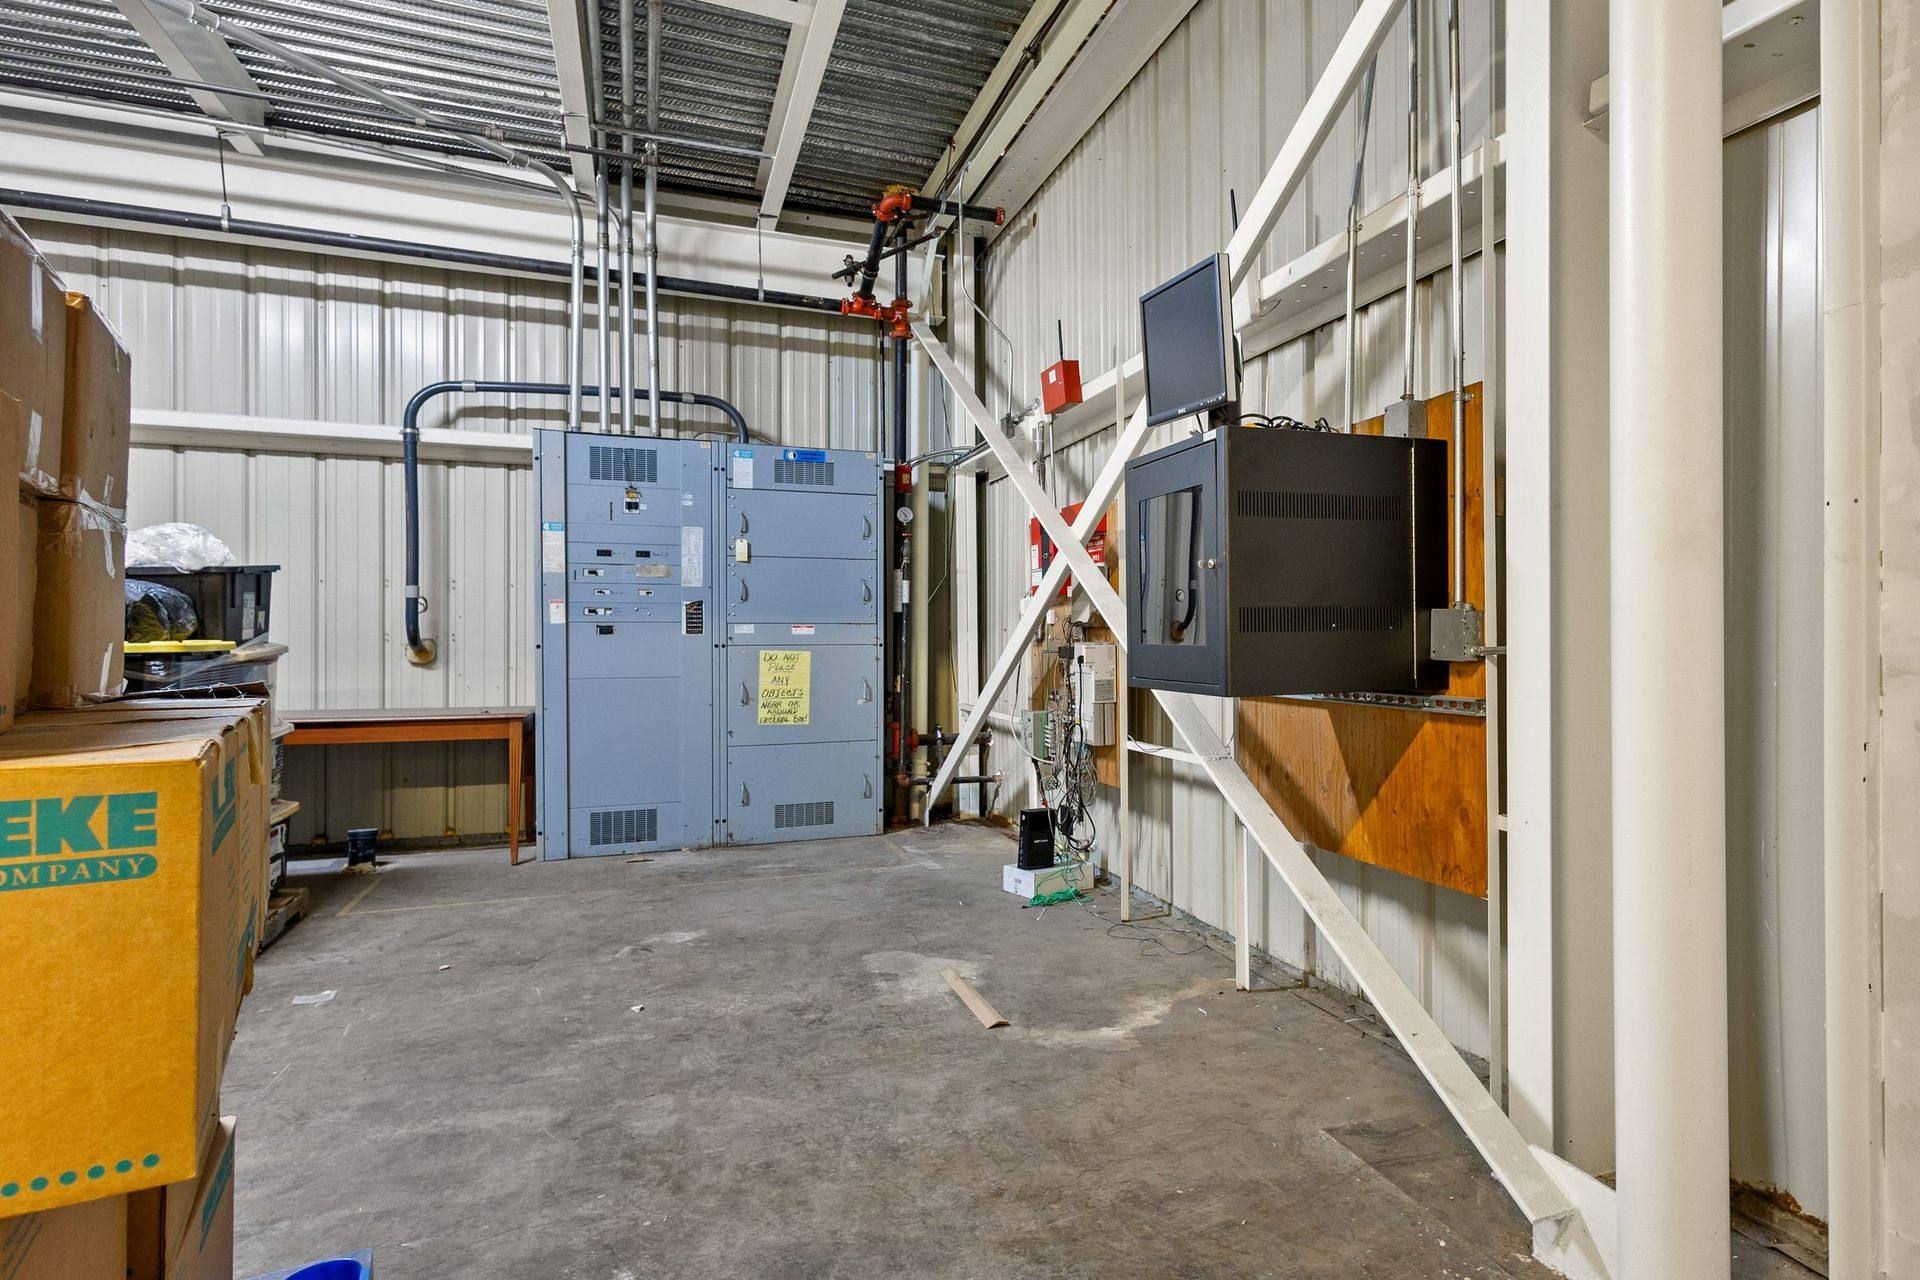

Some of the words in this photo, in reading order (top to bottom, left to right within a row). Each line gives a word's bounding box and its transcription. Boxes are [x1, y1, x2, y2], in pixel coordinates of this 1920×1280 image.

[763, 652, 777, 661] DO
[771, 676, 790, 686] ANY
[761, 688, 804, 698] OBJECTS
